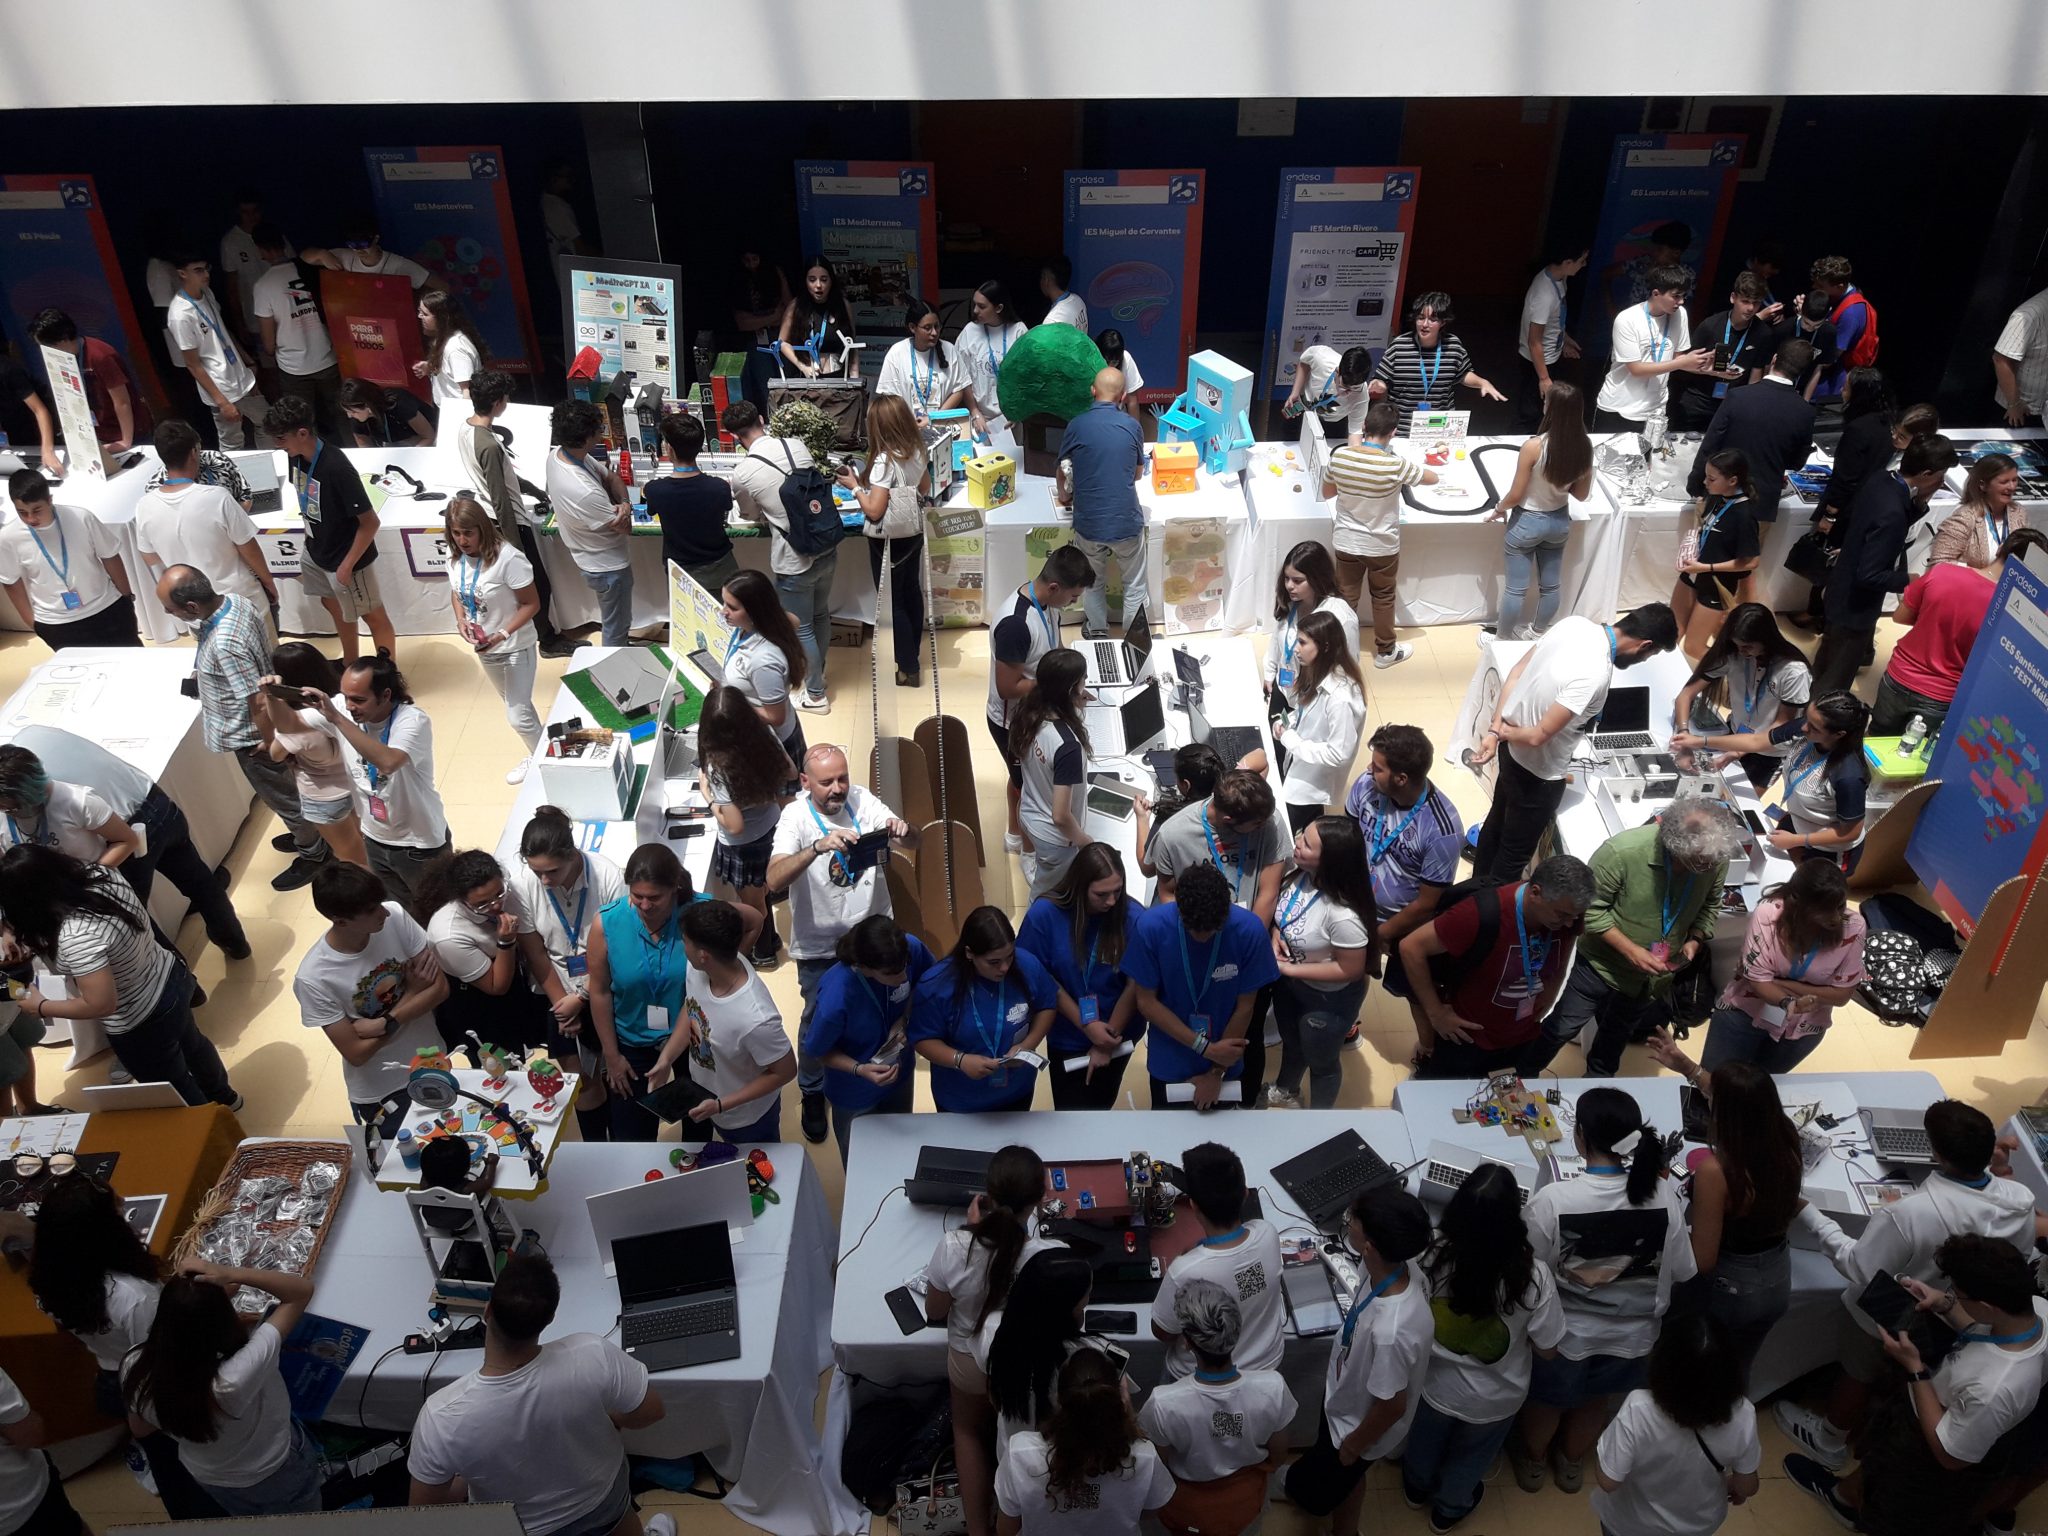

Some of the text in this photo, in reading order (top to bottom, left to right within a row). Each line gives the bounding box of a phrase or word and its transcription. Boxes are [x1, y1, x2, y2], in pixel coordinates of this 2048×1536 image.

[1069, 176, 1105, 185] endesa
[1286, 173, 1321, 182] endesa
[832, 218, 846, 226] IES
[1084, 227, 1181, 237] IES Miguel de Cervantes
[1310, 224, 1323, 233] IES
[1353, 224, 1379, 232] Rivero
[350, 323, 373, 334] PARA
[352, 332, 384, 343] Y PARA
[355, 341, 385, 351] TODOS
[2008, 567, 2039, 598] endesa
[1987, 577, 2011, 628] Fundación
[2000, 635, 2016, 656] CES
[2014, 649, 2048, 689] Santísima
[2013, 665, 2033, 688] FEST
